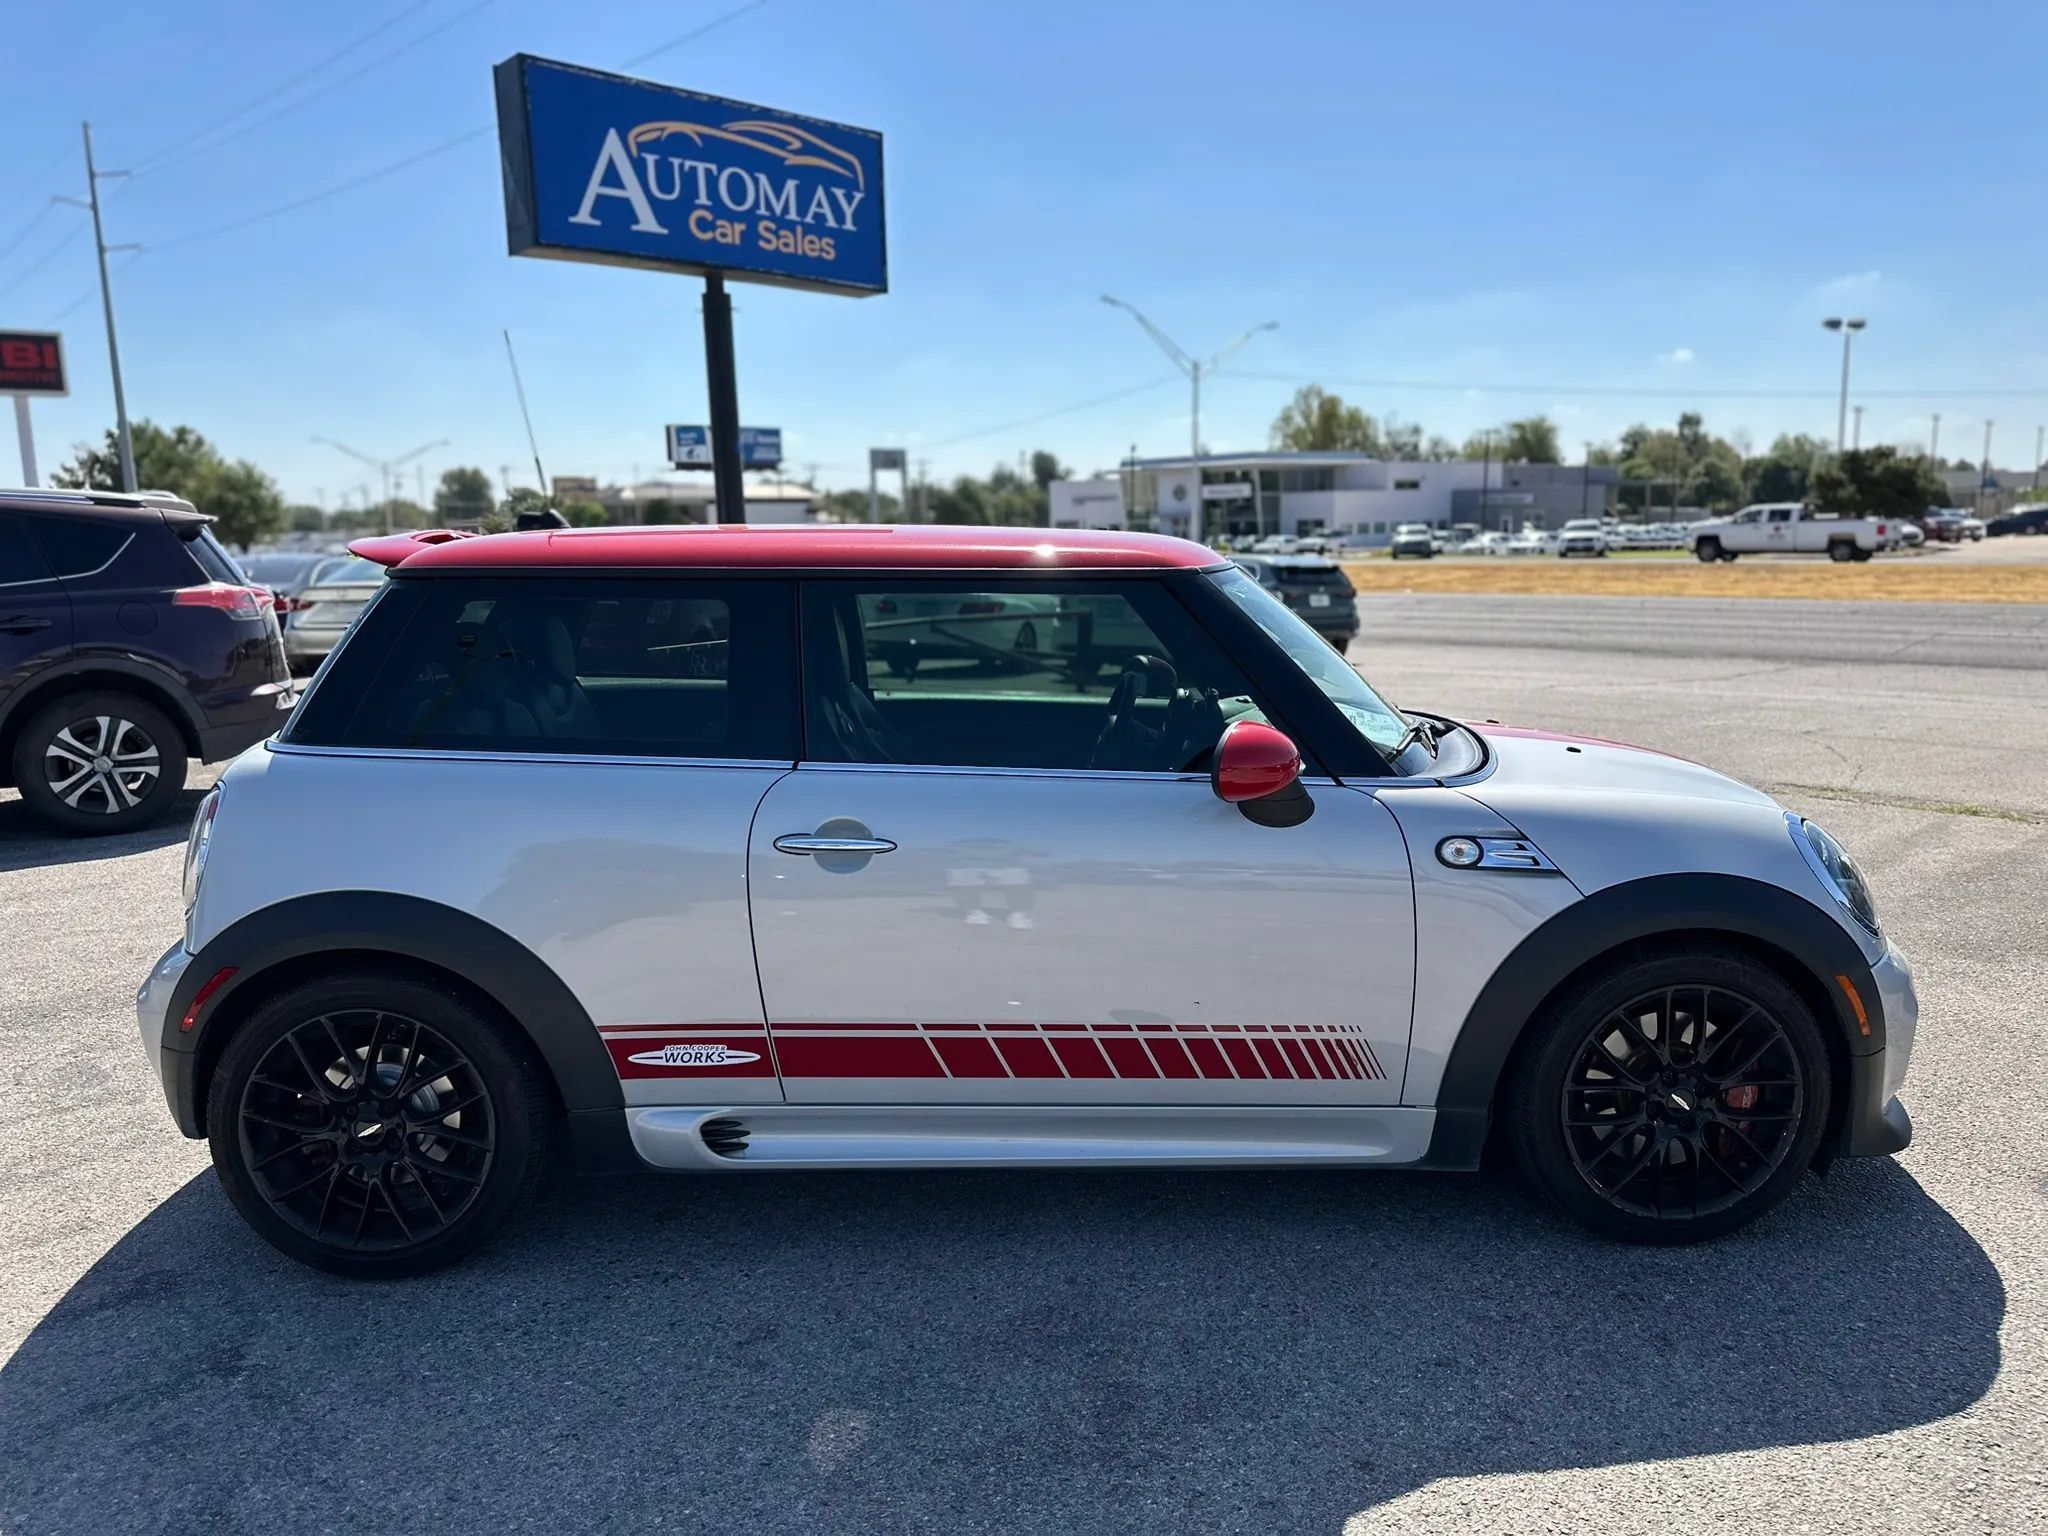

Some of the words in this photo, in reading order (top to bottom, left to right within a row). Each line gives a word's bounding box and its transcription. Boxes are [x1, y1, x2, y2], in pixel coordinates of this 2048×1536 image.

[688, 208, 747, 246] Car
[757, 219, 837, 261] Sales
[664, 1051, 726, 1063] WORKS
